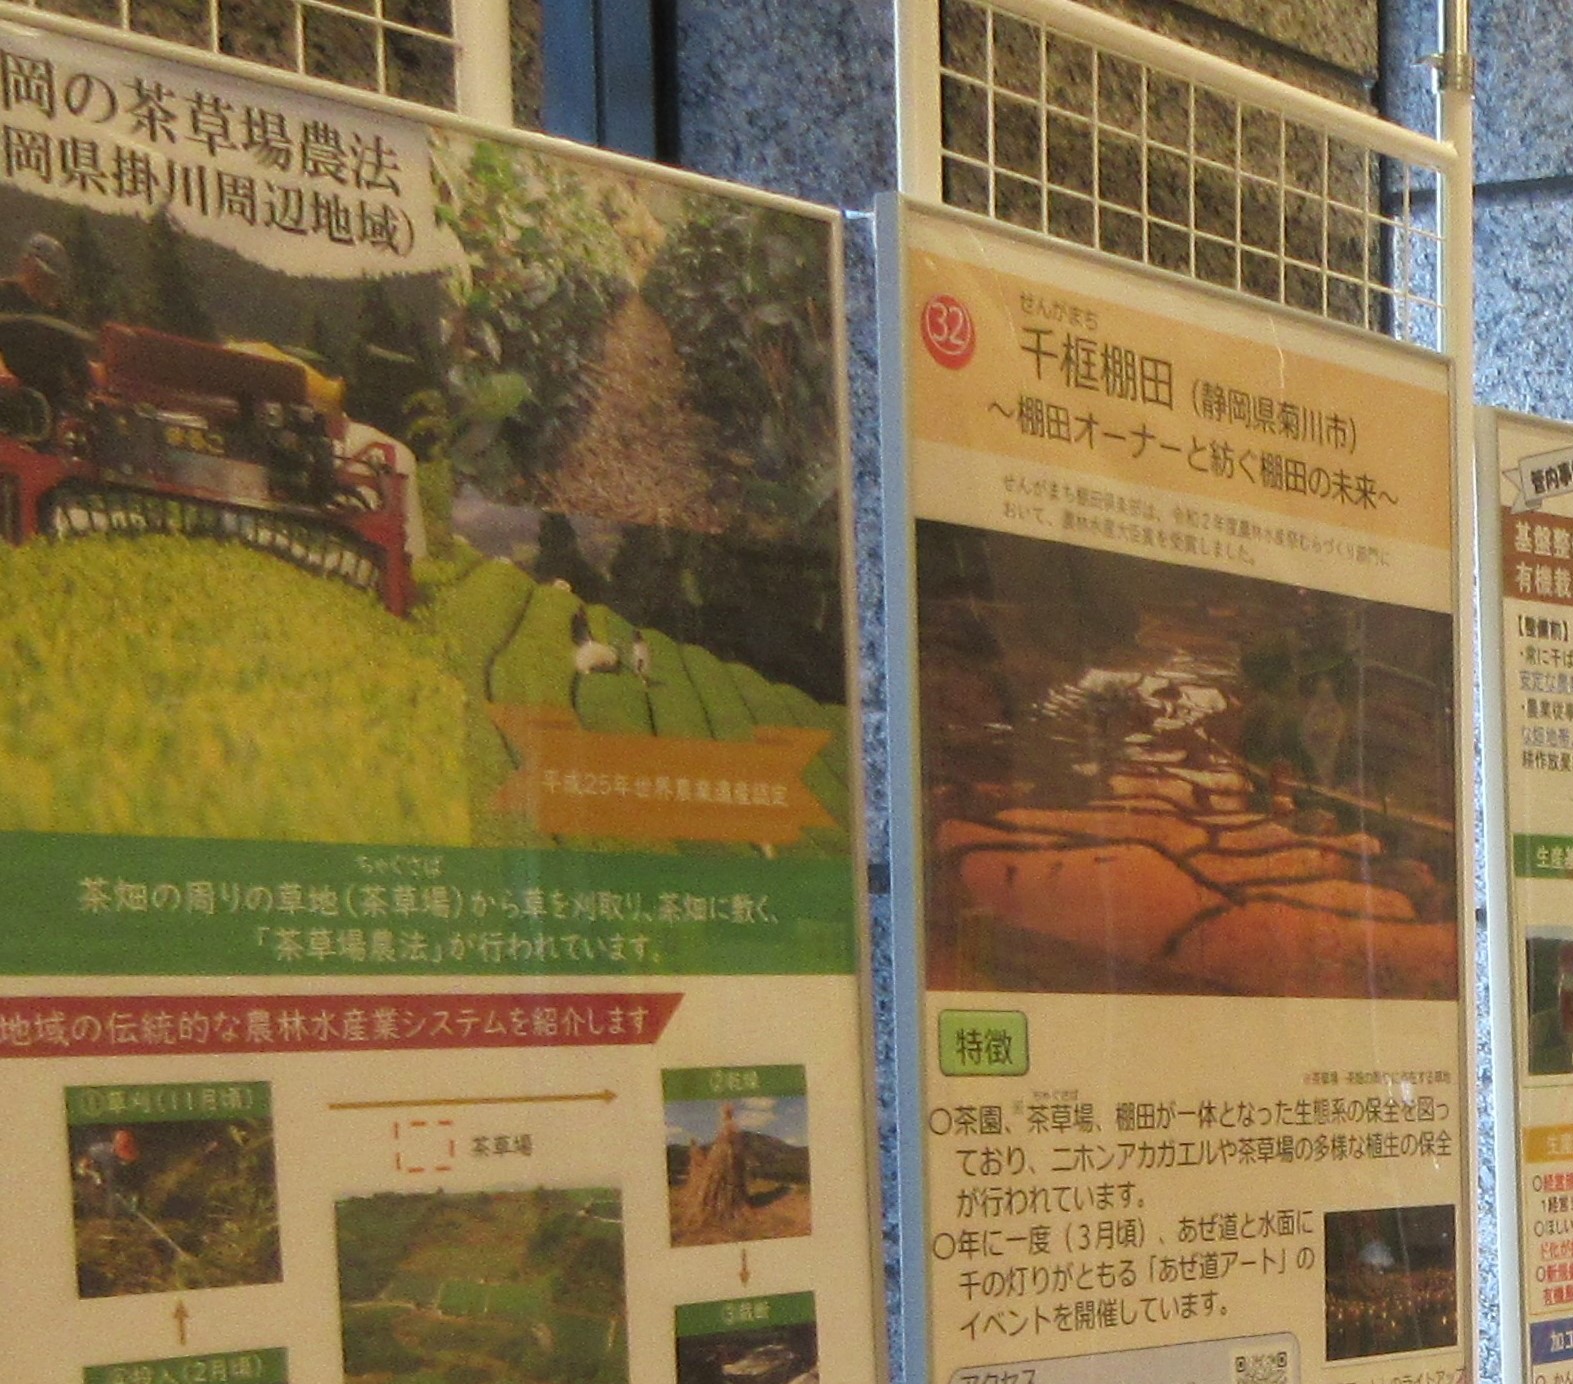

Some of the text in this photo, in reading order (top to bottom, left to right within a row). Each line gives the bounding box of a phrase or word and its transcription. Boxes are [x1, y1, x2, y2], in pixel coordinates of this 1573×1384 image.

[1019, 291, 1099, 331] せんがまち
[955, 1027, 1014, 1067] 特徴
[471, 1133, 533, 1157] 茶草場
[956, 1181, 1144, 1218] が行われています。
[961, 1290, 1227, 1341] イベントを開催しています。
